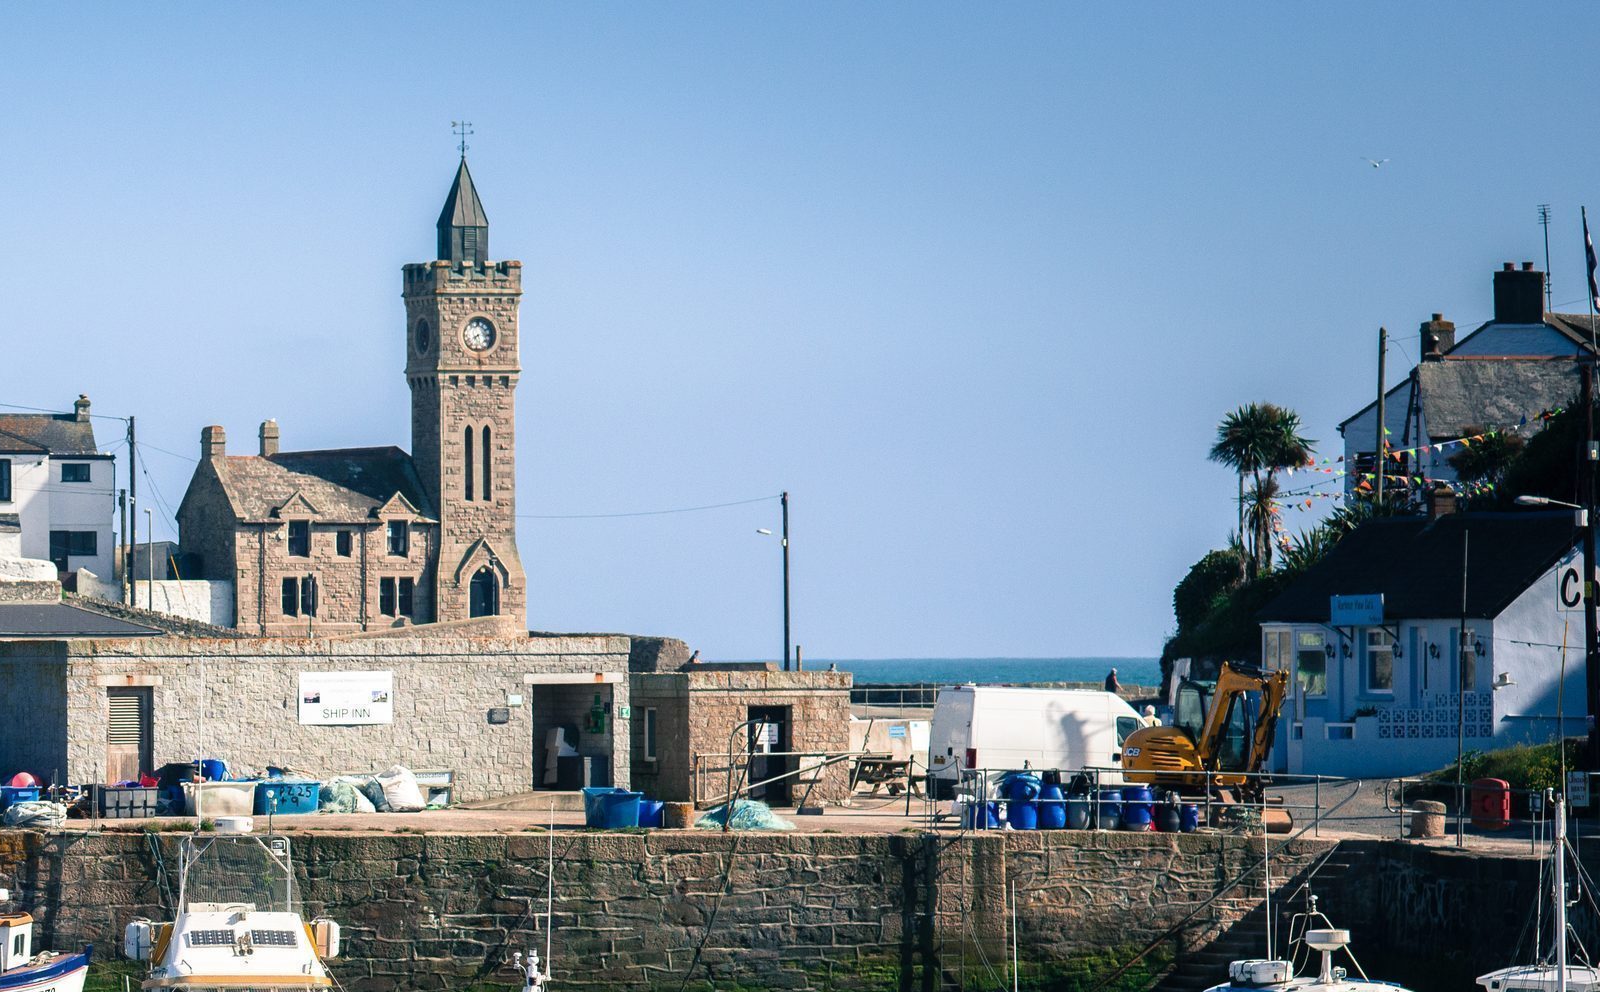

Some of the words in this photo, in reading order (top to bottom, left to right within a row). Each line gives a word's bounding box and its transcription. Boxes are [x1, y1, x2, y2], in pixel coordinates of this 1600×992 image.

[323, 708, 349, 719] SHIP
[352, 708, 371, 718] INN
[1123, 746, 1141, 757] JCB
[297, 786, 312, 798] 25
